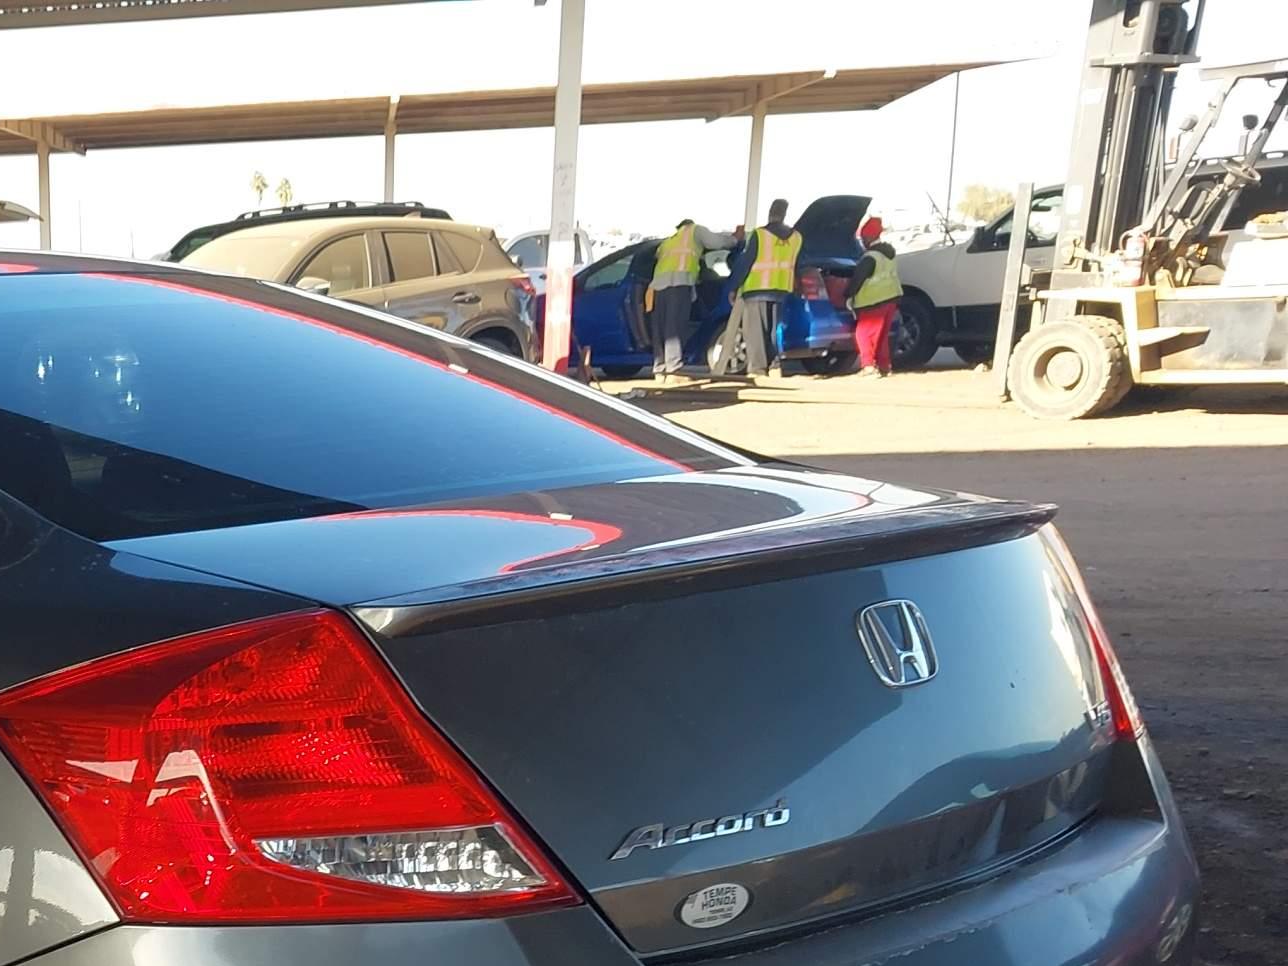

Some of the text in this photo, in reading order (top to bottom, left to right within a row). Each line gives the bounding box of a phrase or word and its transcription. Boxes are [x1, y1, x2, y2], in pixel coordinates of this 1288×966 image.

[608, 797, 790, 860] Accord
[703, 886, 738, 900] TEMPE
[701, 896, 737, 910] HONDA
